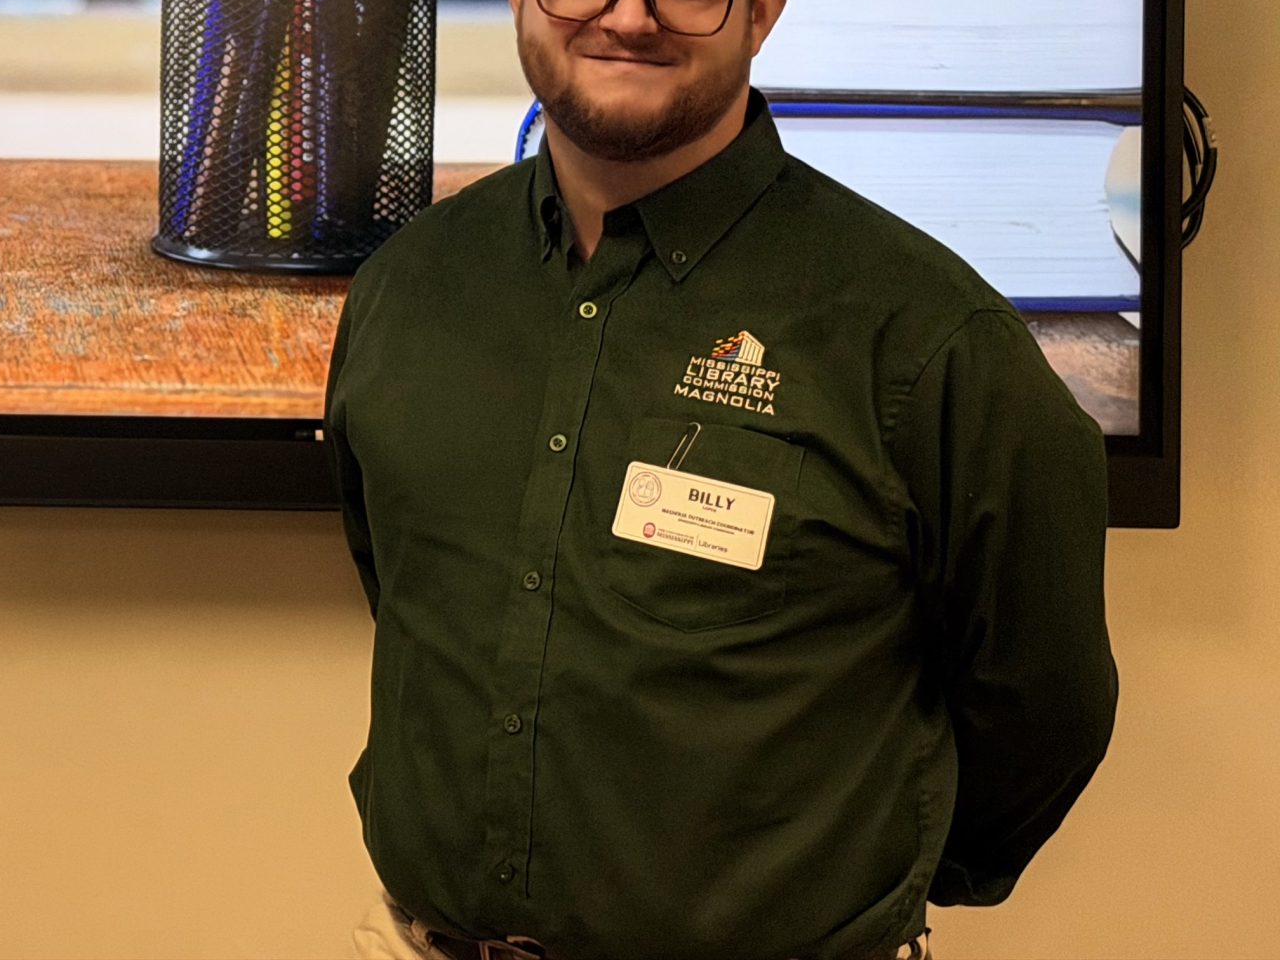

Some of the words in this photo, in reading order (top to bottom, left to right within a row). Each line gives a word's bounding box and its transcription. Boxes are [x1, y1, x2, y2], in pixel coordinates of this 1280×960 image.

[686, 364, 780, 392] LIBRARY
[689, 356, 781, 381] MISSISSIPPI
[673, 384, 775, 416] MAGNOLIA
[682, 375, 775, 401] COMMISSION
[688, 487, 736, 511] BILLY
[698, 539, 728, 553] Libraries
